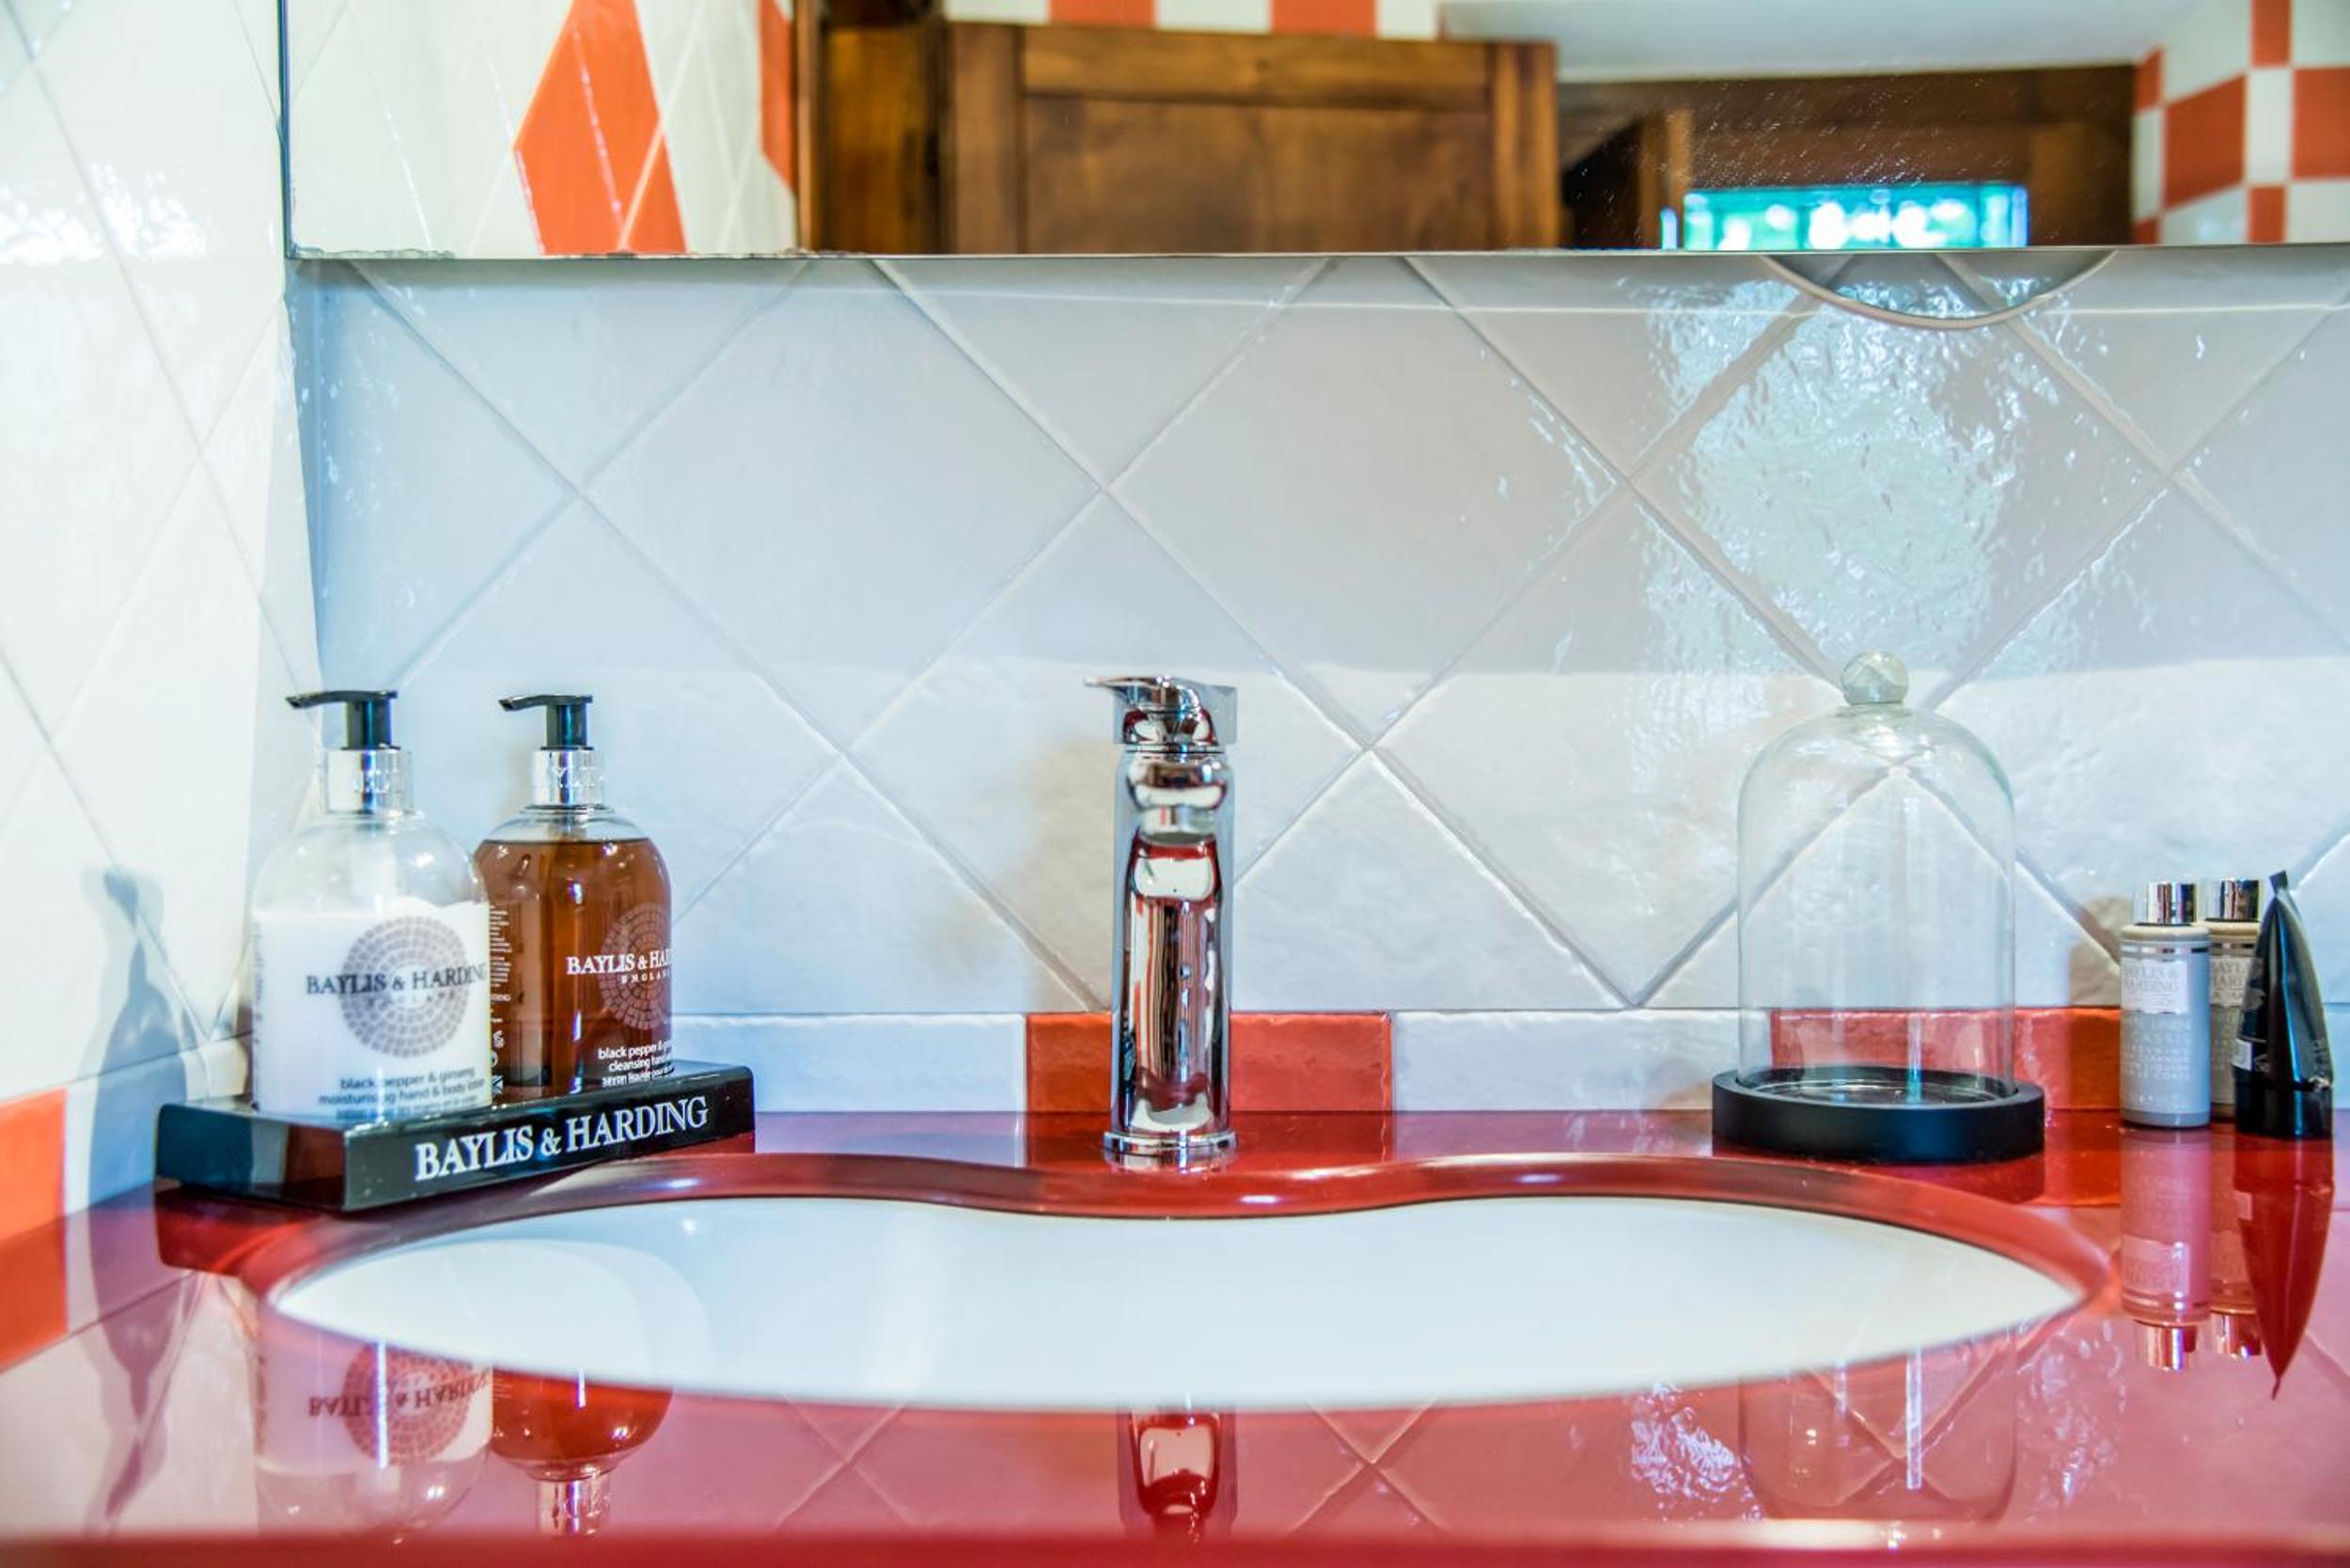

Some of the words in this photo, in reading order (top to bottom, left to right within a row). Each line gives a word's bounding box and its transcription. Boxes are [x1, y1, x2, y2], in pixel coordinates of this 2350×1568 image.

[567, 955, 635, 975] BAYLIS
[637, 955, 648, 970] &
[306, 975, 386, 995] BAYLIS
[392, 977, 406, 990] &
[598, 1047, 627, 1059] black
[628, 1043, 656, 1059] pepper
[608, 1058, 650, 1072] cleansing
[340, 1078, 374, 1090] black
[379, 1074, 425, 1089] epper
[399, 1088, 429, 1100] hand
[415, 1125, 534, 1182] BAYLIS
[540, 1129, 562, 1157] &
[566, 1095, 710, 1152] HARDING
